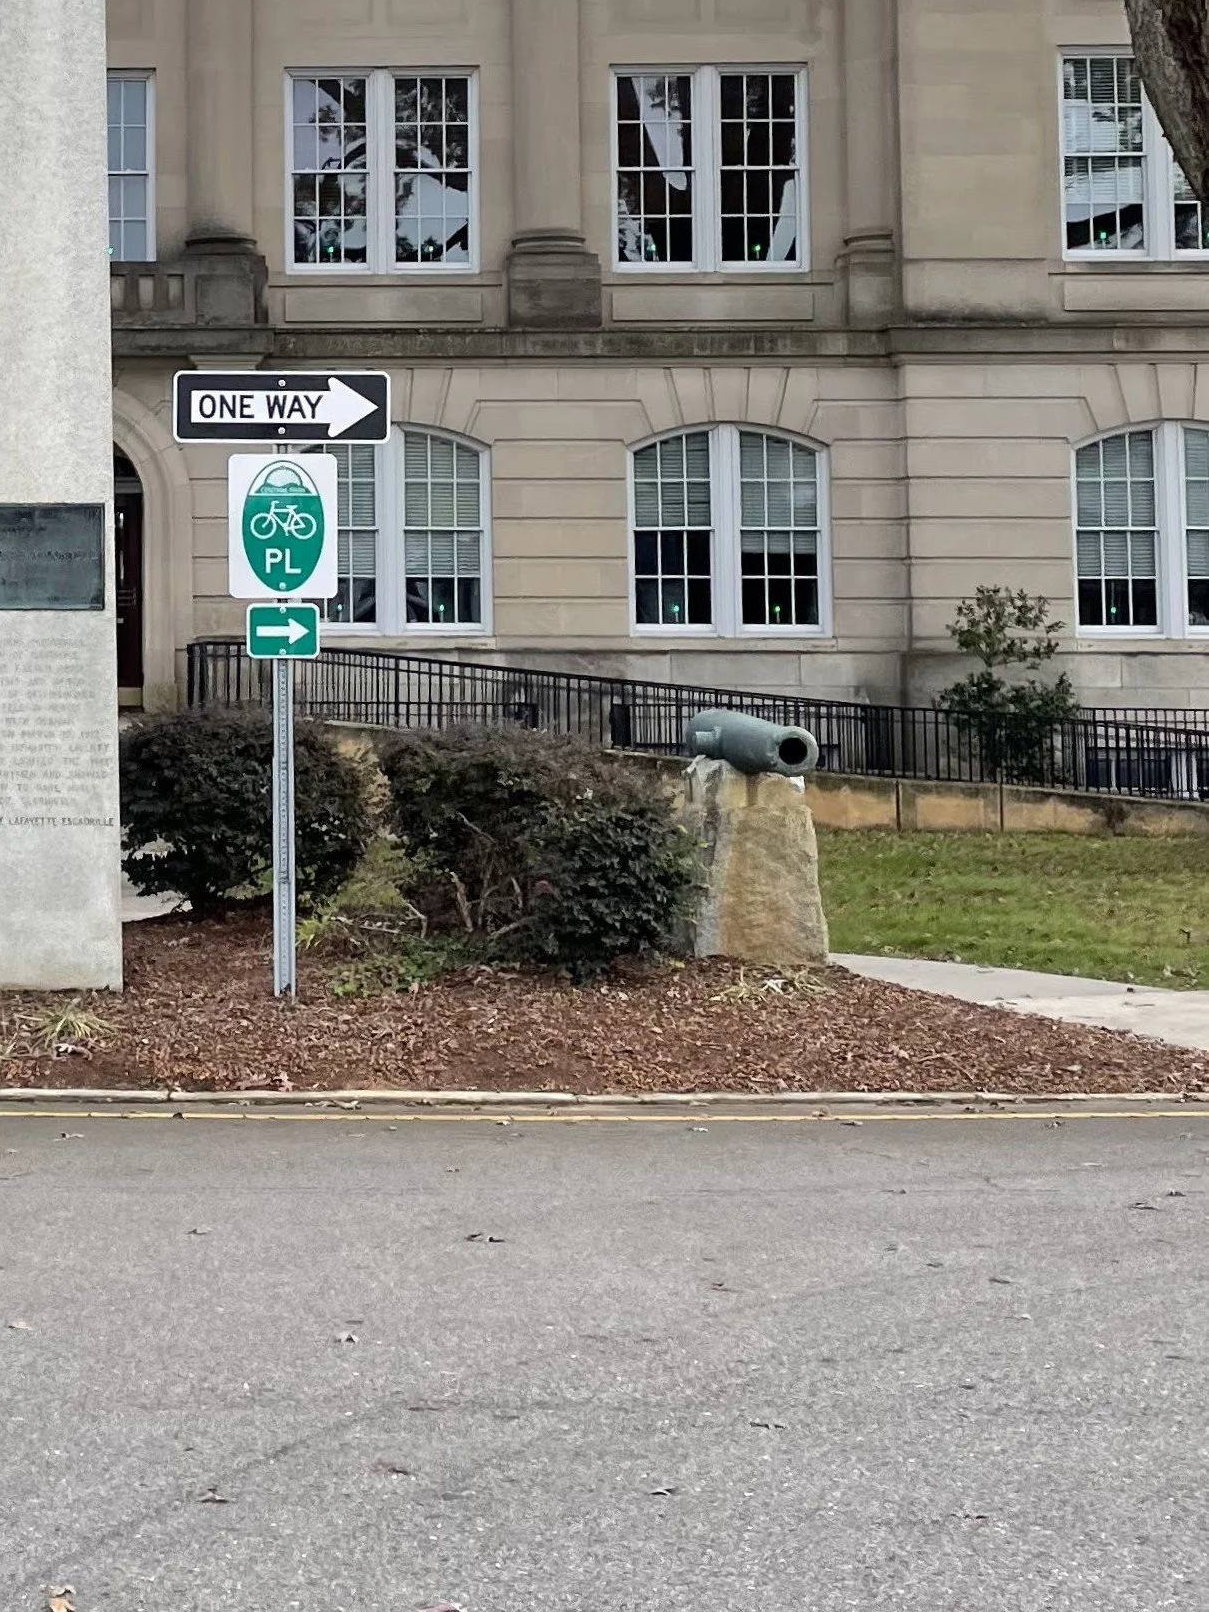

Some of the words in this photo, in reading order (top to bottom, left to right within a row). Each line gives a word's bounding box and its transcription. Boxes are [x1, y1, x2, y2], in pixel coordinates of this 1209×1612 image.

[199, 394, 255, 419] ONE
[266, 394, 324, 419] WAY
[265, 548, 302, 574] PL
[8, 816, 58, 827] LAFAYETTE
[61, 816, 115, 827] ESCADRILLE
